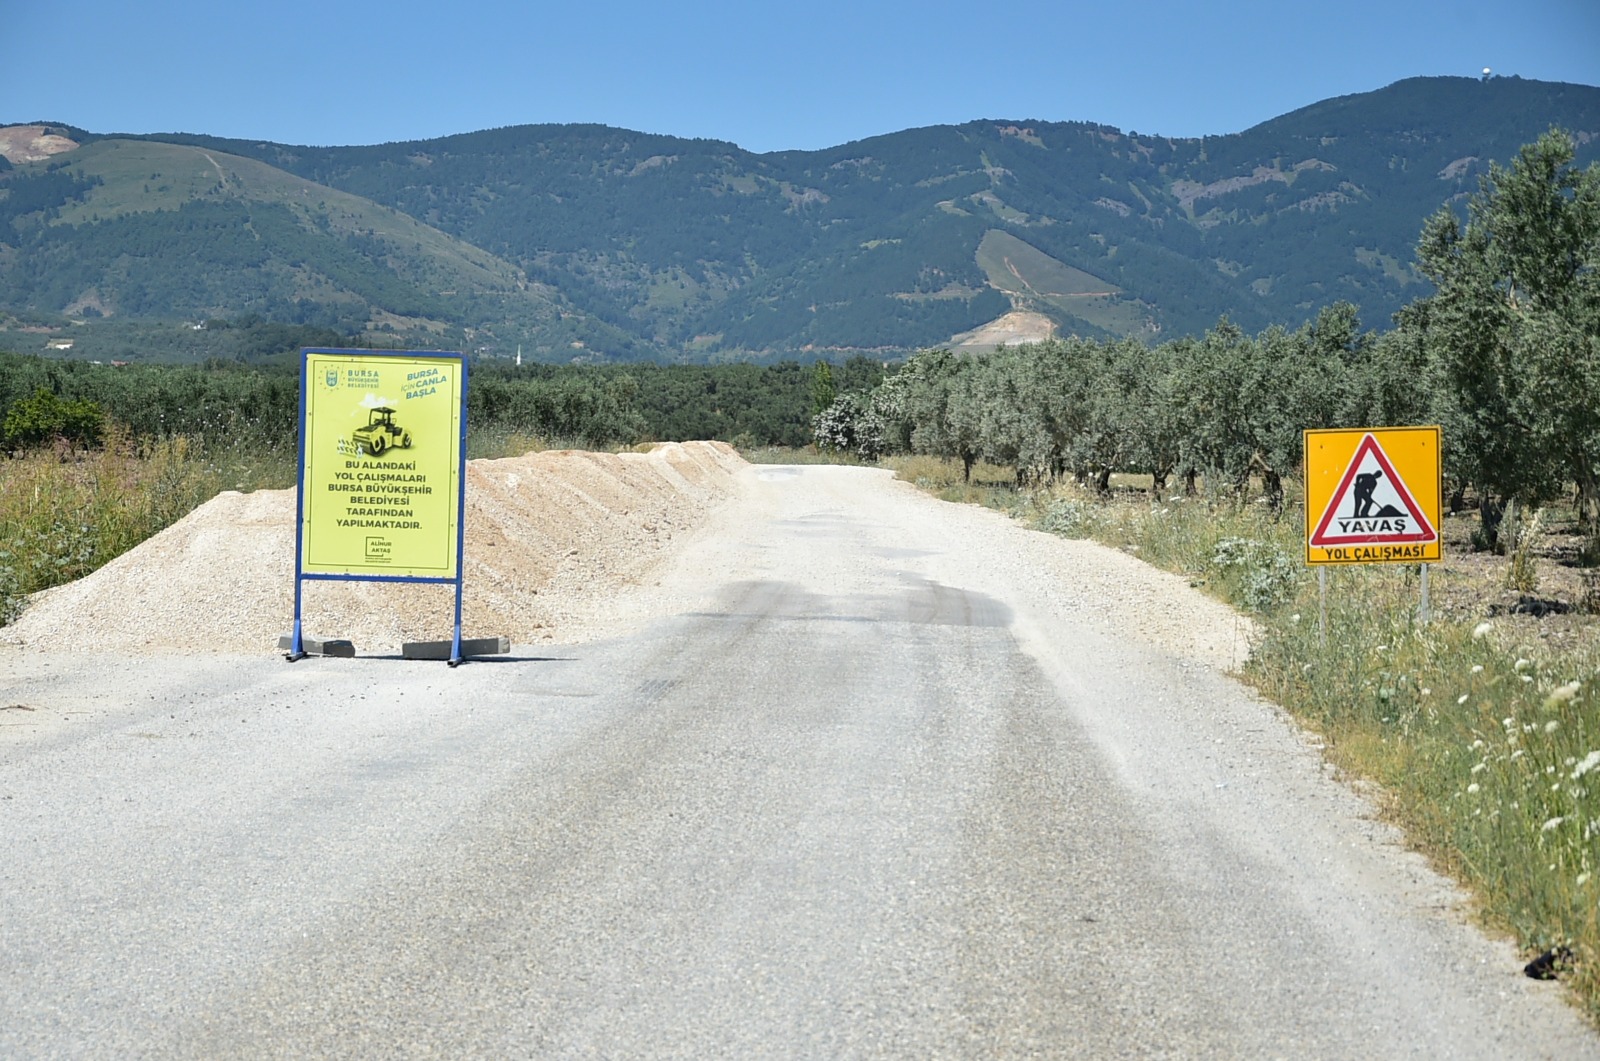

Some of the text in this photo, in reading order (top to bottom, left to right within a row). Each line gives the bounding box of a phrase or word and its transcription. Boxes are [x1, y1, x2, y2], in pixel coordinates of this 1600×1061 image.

[407, 368, 439, 381] BURSA
[416, 376, 447, 388] CANLA
[406, 387, 436, 399] BAŞLA
[362, 461, 416, 470] ALANDAKİ
[334, 472, 426, 483] YOL ÇALIŞMALARI
[328, 483, 432, 496] BURSA BÜYÜKŞEHİR
[350, 495, 410, 505] BELEDİYESİ
[346, 508, 413, 517] TARAFINDAN
[336, 519, 423, 529] YAPILMAKTADIR.
[1338, 519, 1406, 534] YAVAŞ
[1325, 548, 1350, 559] YOL
